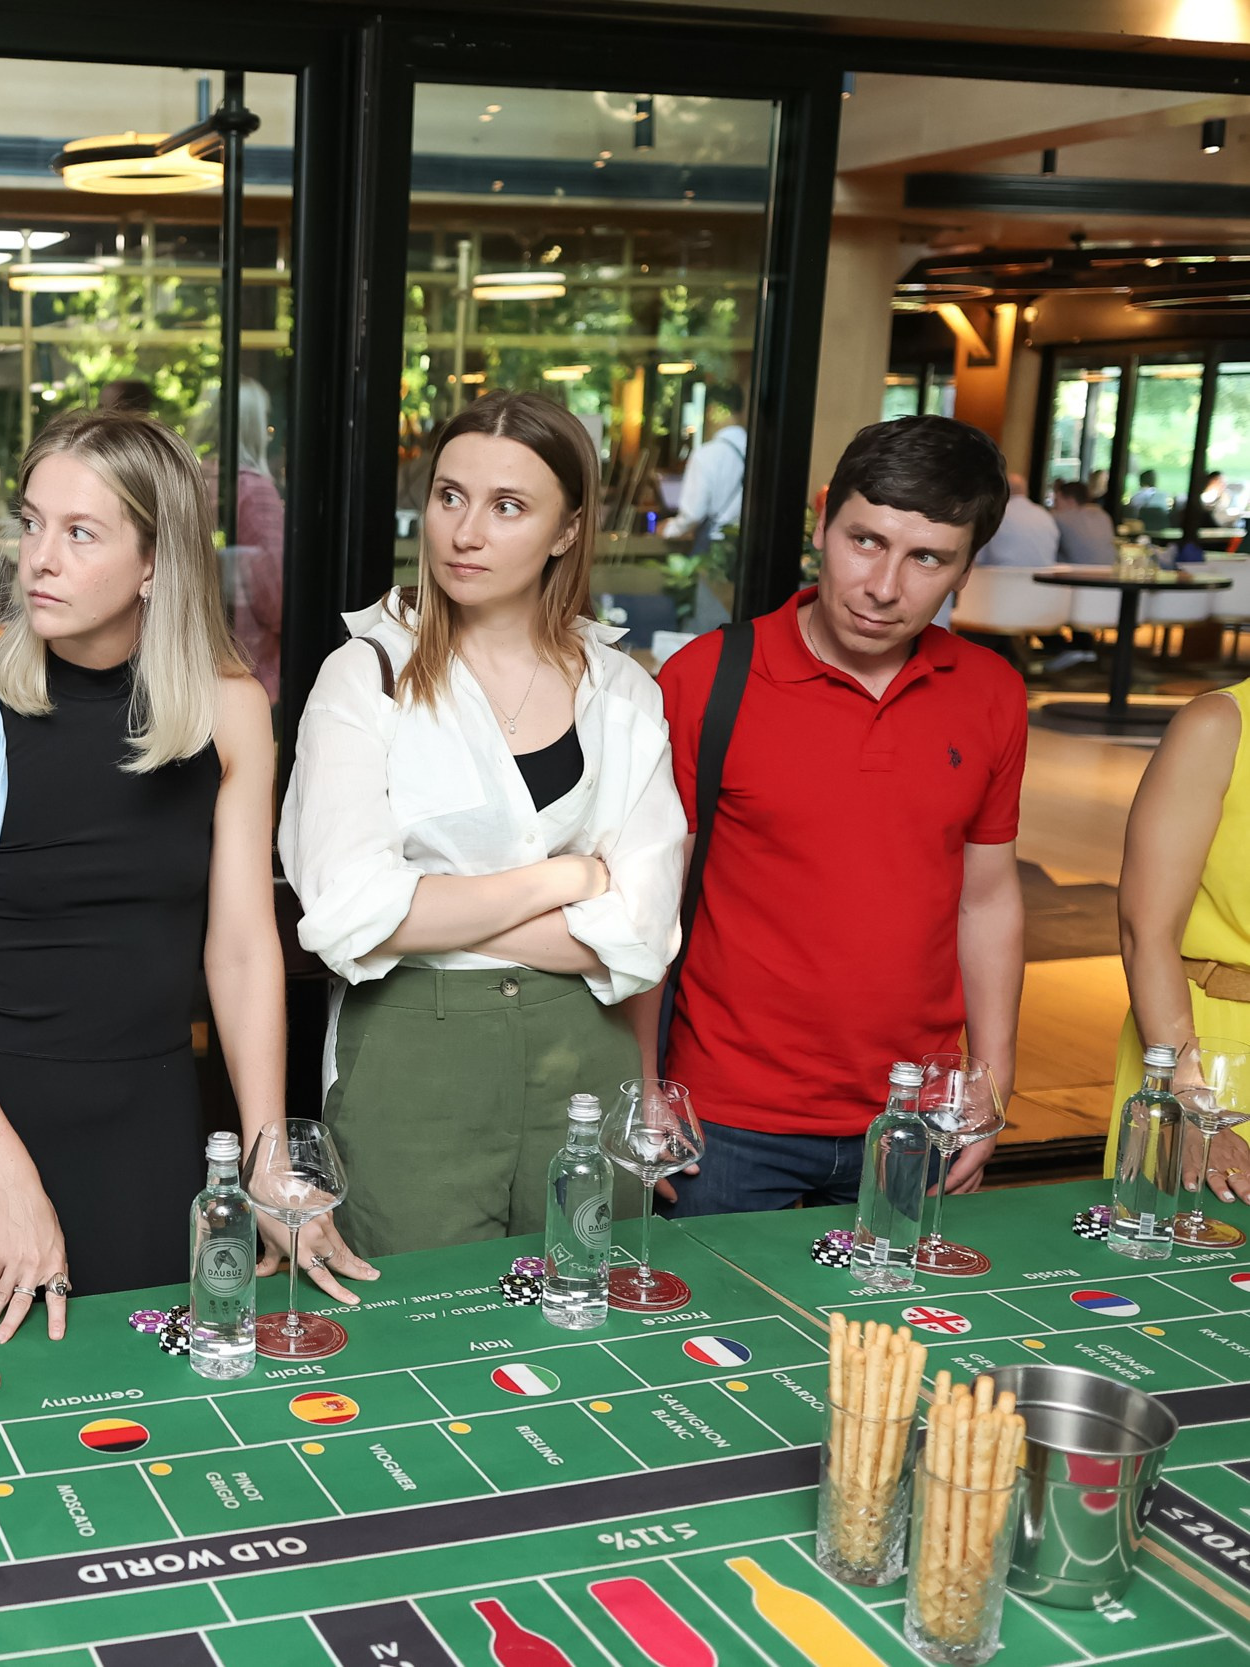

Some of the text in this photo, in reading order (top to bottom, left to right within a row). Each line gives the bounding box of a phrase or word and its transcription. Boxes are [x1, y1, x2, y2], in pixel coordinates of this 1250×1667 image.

[1176, 1252, 1237, 1263] Austria
[207, 1268, 242, 1277] DAUSUZ
[1022, 1268, 1082, 1281] Russia
[411, 1292, 454, 1304] GAME
[455, 1286, 503, 1298] CARDS
[362, 1299, 400, 1311] WINE
[451, 1303, 501, 1316] WORLD
[404, 1311, 437, 1322] ALC.
[642, 1310, 712, 1327] France
[469, 1339, 514, 1353] Italy
[1074, 1343, 1142, 1381] VELTLINER
[1097, 1344, 1156, 1376] GRÜNER
[265, 1364, 326, 1380] Spain
[40, 1388, 145, 1410] Germany
[772, 1372, 825, 1413] CHARDO
[650, 1409, 695, 1441] BLANC
[658, 1392, 731, 1449] SAUVIGNON
[515, 1424, 565, 1467] RIESLING
[368, 1443, 418, 1493] VIOGNIER
[205, 1471, 240, 1510] GRIGIO
[232, 1471, 264, 1503] PINOT
[56, 1484, 96, 1537] MOSCATO
[77, 1536, 308, 1584] OLD WORLD
